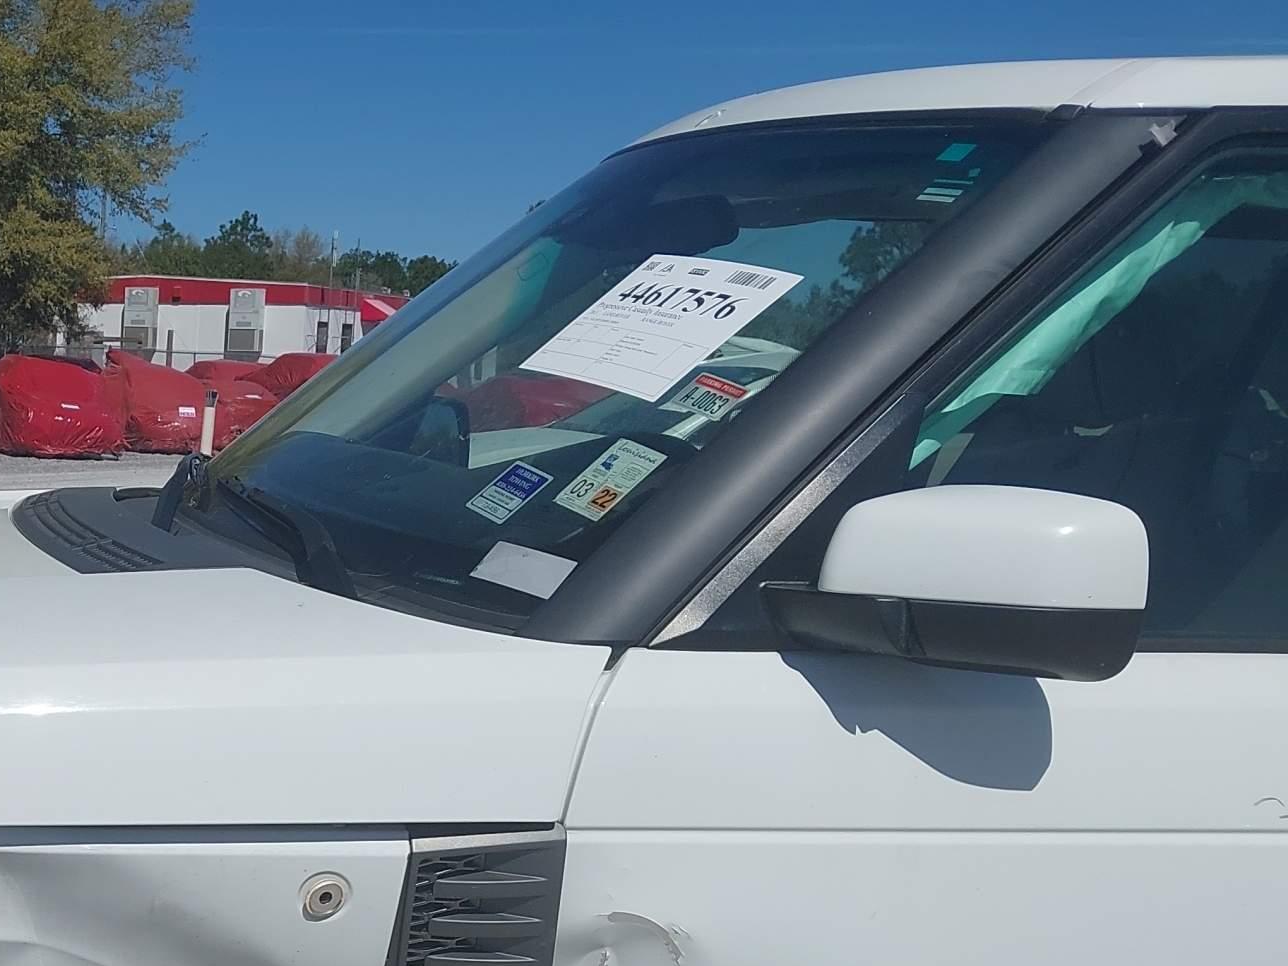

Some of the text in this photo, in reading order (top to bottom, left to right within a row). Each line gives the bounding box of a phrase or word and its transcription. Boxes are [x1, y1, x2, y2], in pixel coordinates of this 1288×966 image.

[618, 281, 750, 320] 44617576
[680, 386, 730, 415] A-0063
[570, 479, 594, 498] 03
[591, 489, 618, 508] 22
